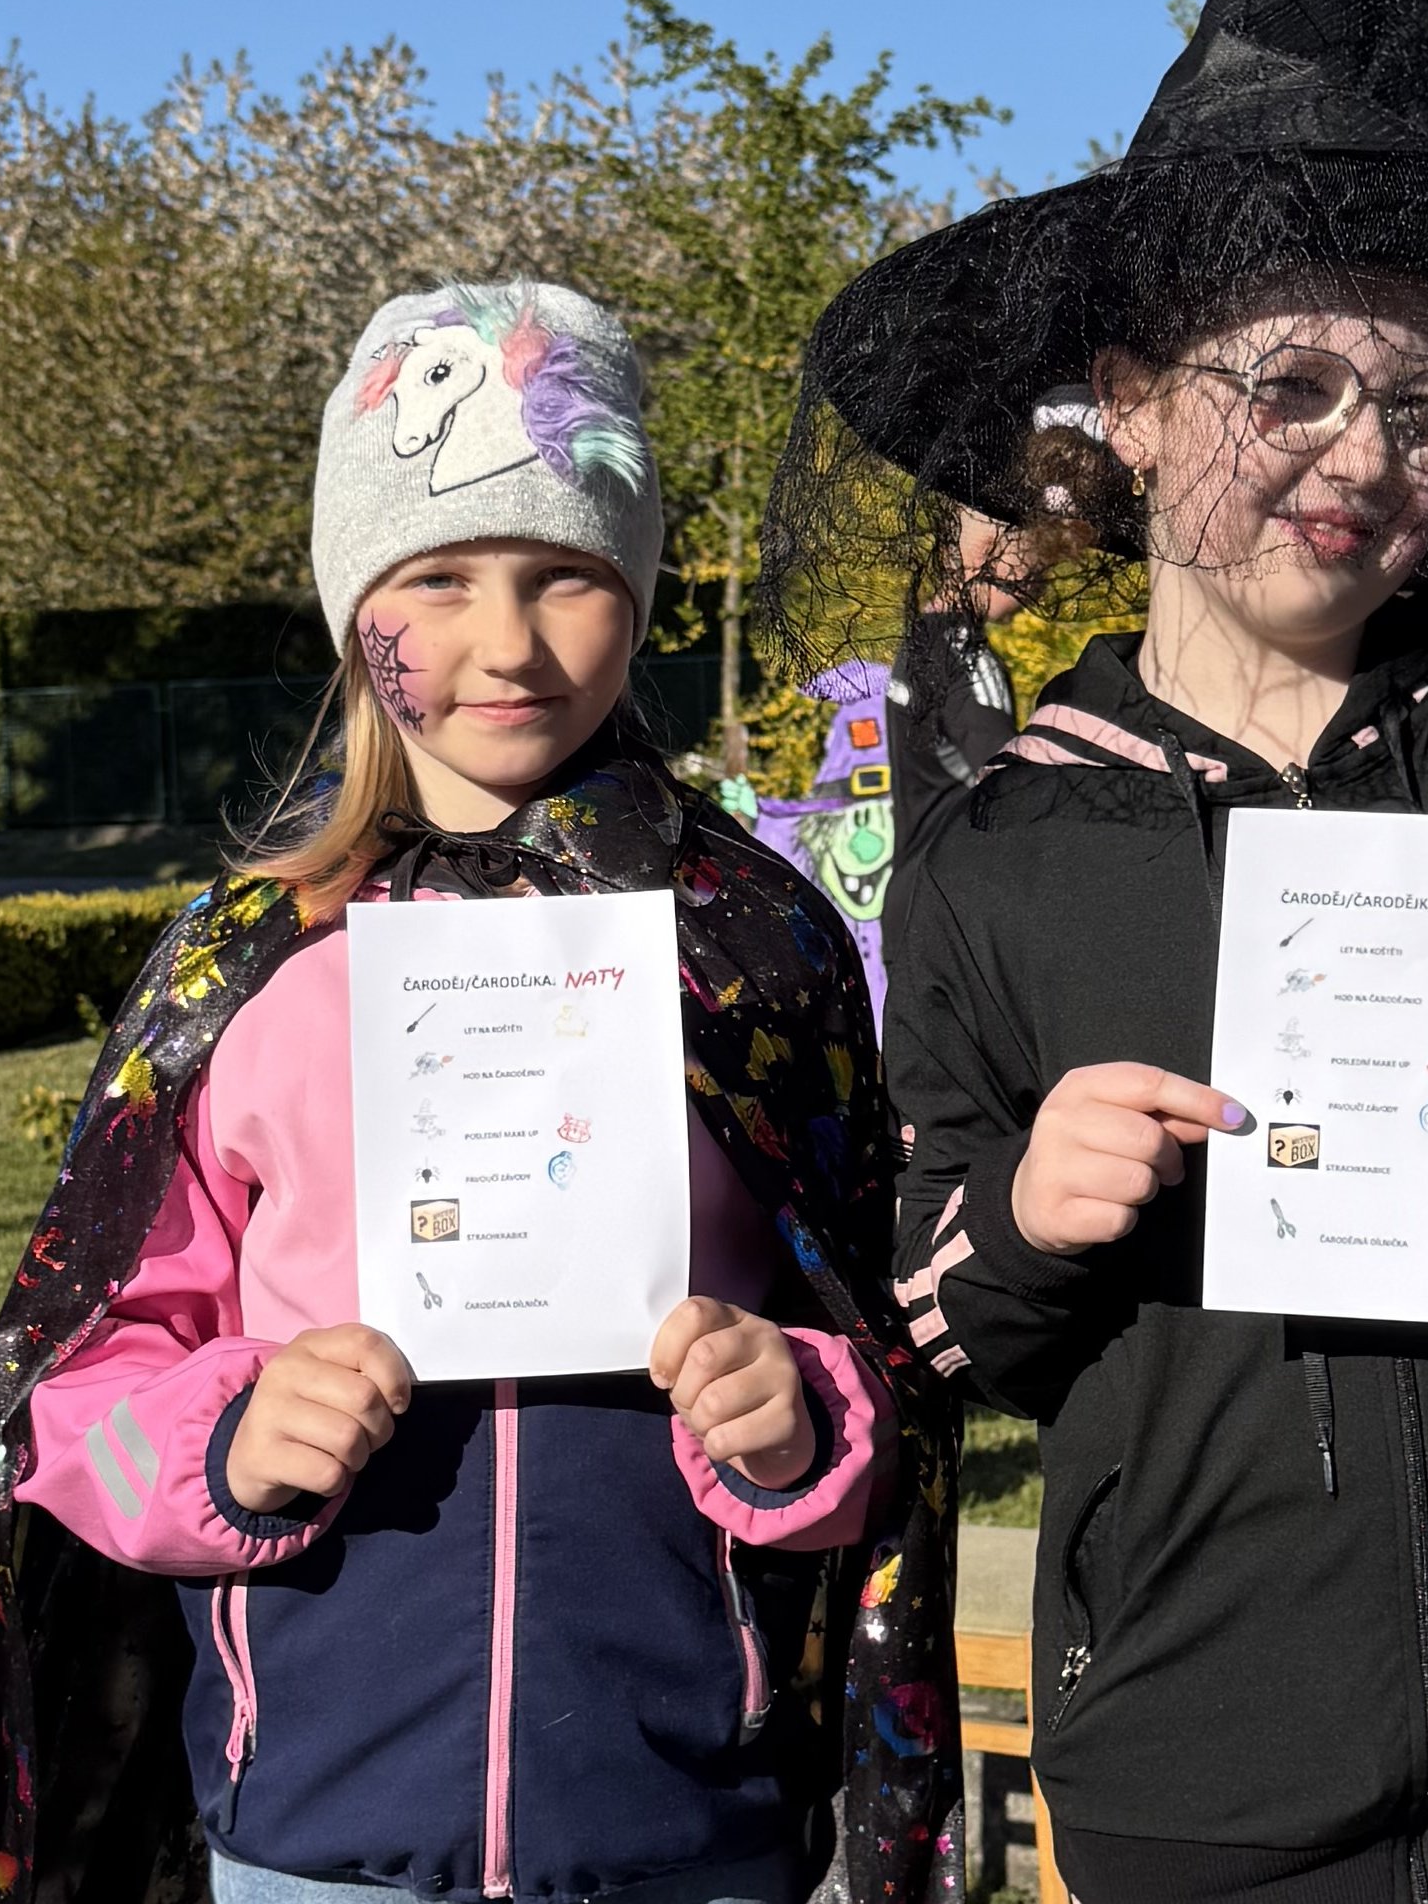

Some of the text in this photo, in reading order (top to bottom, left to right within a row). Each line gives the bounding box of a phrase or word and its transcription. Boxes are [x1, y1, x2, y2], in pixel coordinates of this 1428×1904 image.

[1340, 946, 1353, 954] LET
[403, 967, 625, 992] ČARODĚJ/ČARODĚJKA: NATY
[464, 1027, 476, 1035] LET
[1291, 1142, 1315, 1163] BOX
[433, 1214, 456, 1236] BOX
